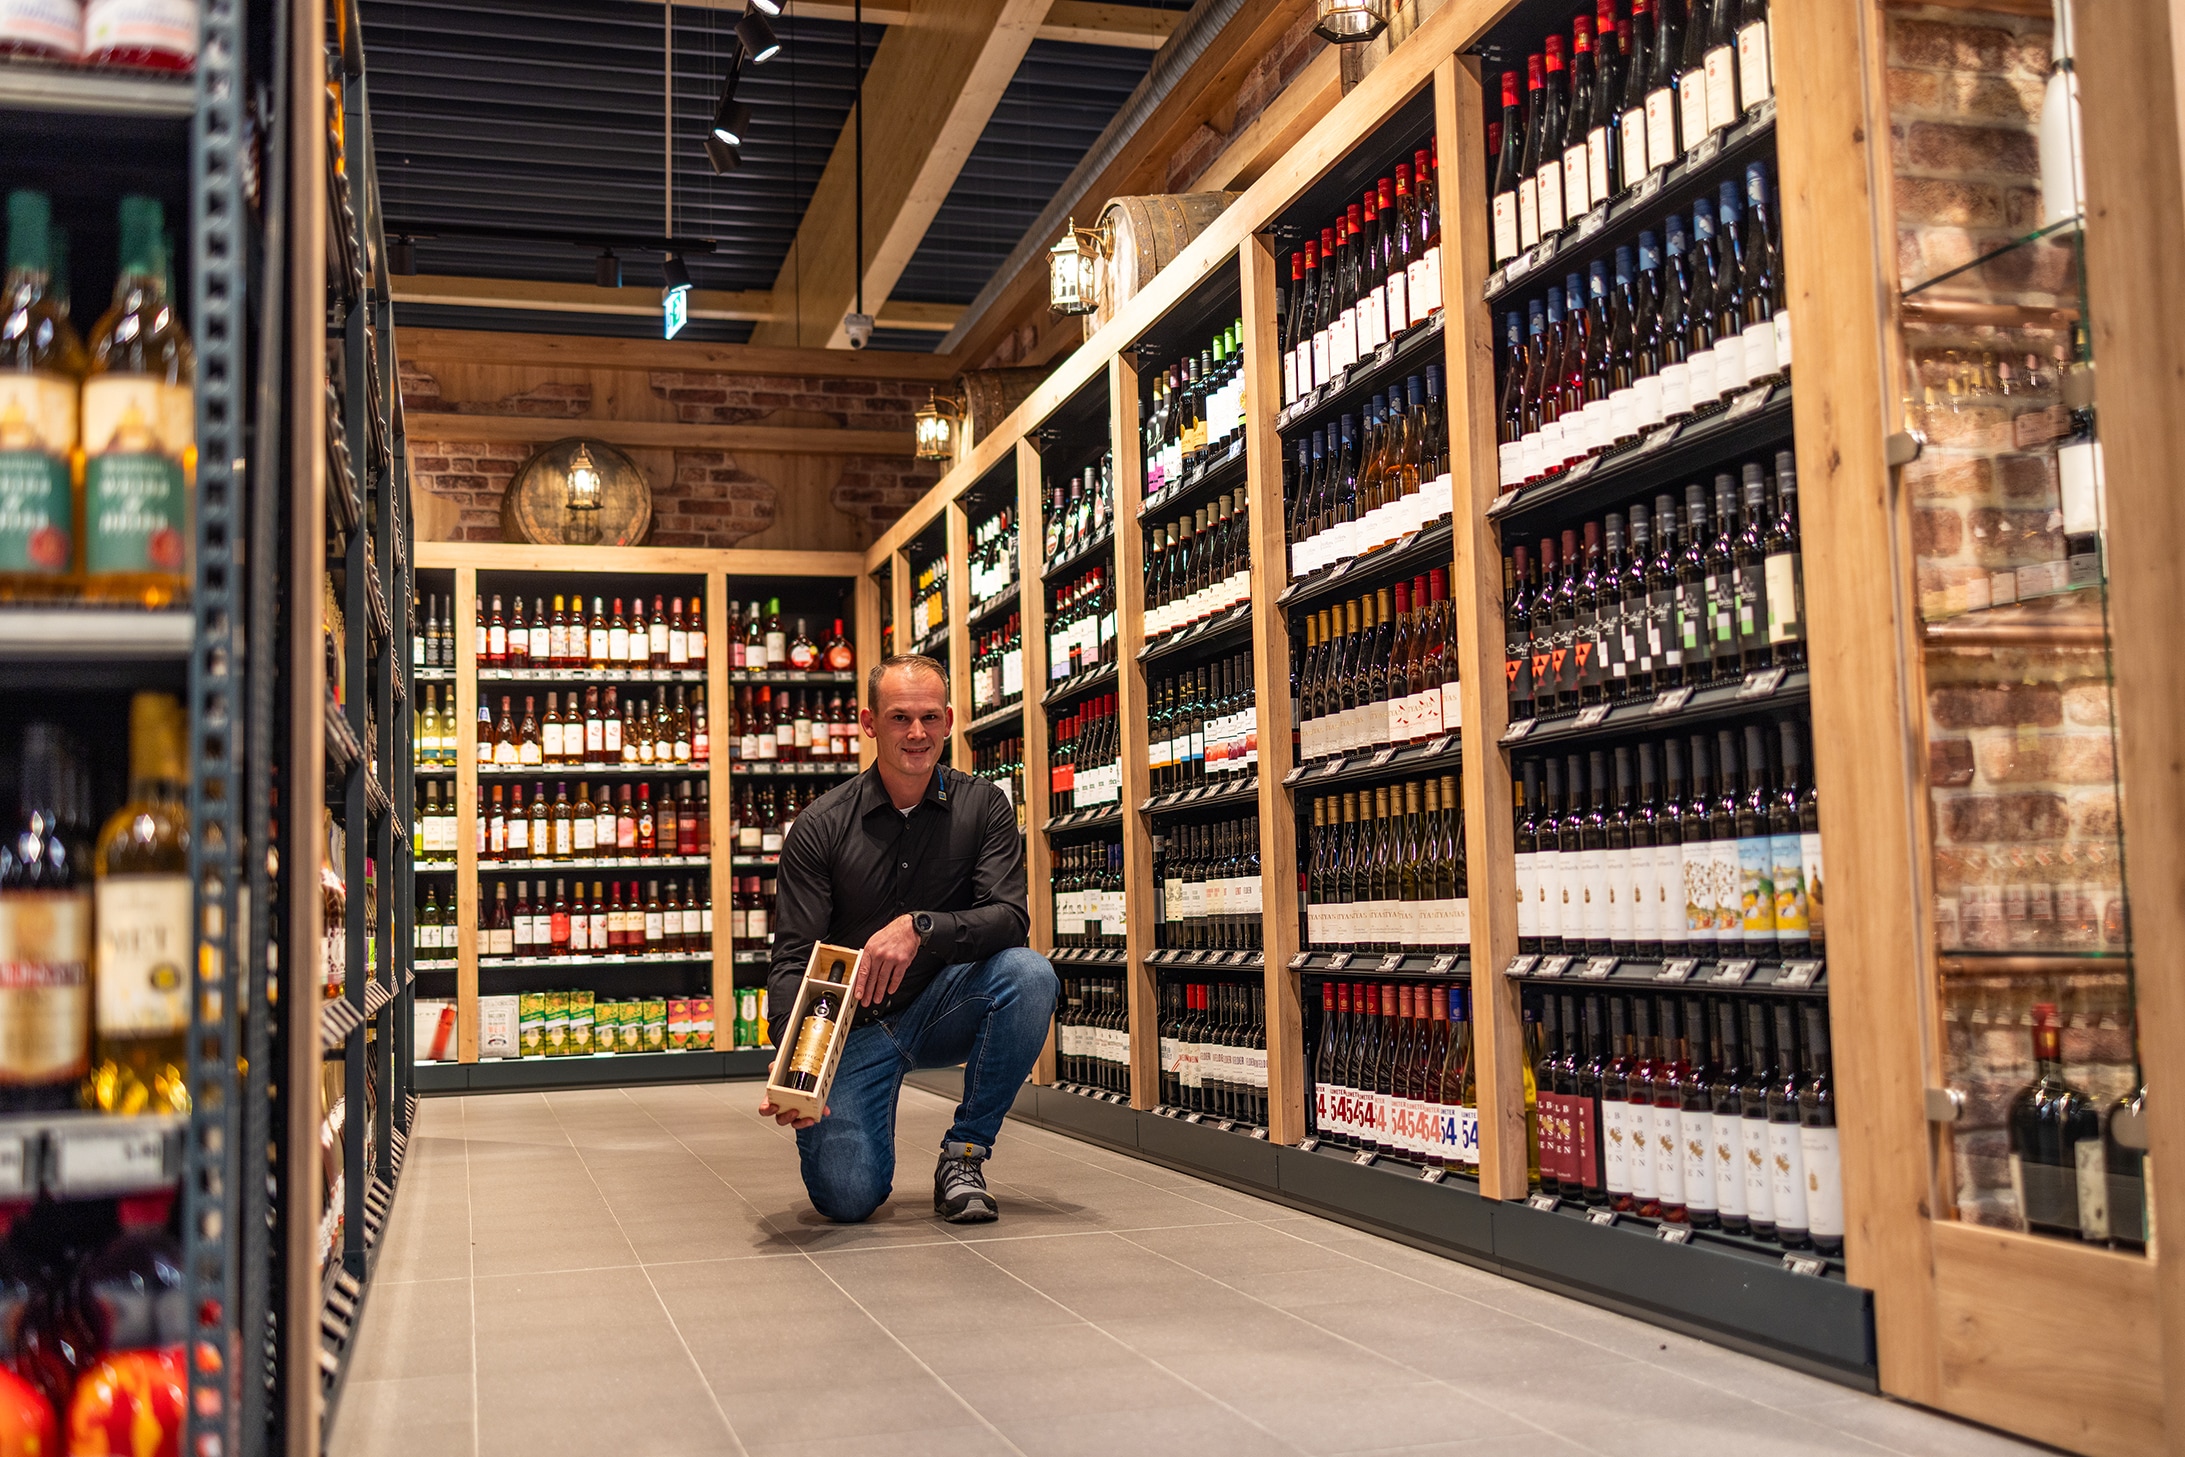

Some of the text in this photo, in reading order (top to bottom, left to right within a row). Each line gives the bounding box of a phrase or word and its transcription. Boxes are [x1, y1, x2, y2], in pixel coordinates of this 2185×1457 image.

[1331, 1096, 1346, 1121] 54
[1359, 1102, 1375, 1128] 54
[1392, 1108, 1408, 1136] 54
[1408, 1111, 1425, 1139] 54
[1425, 1114, 1441, 1143] 54
[1441, 1116, 1457, 1145] 54
[1462, 1120, 1478, 1149] 54
